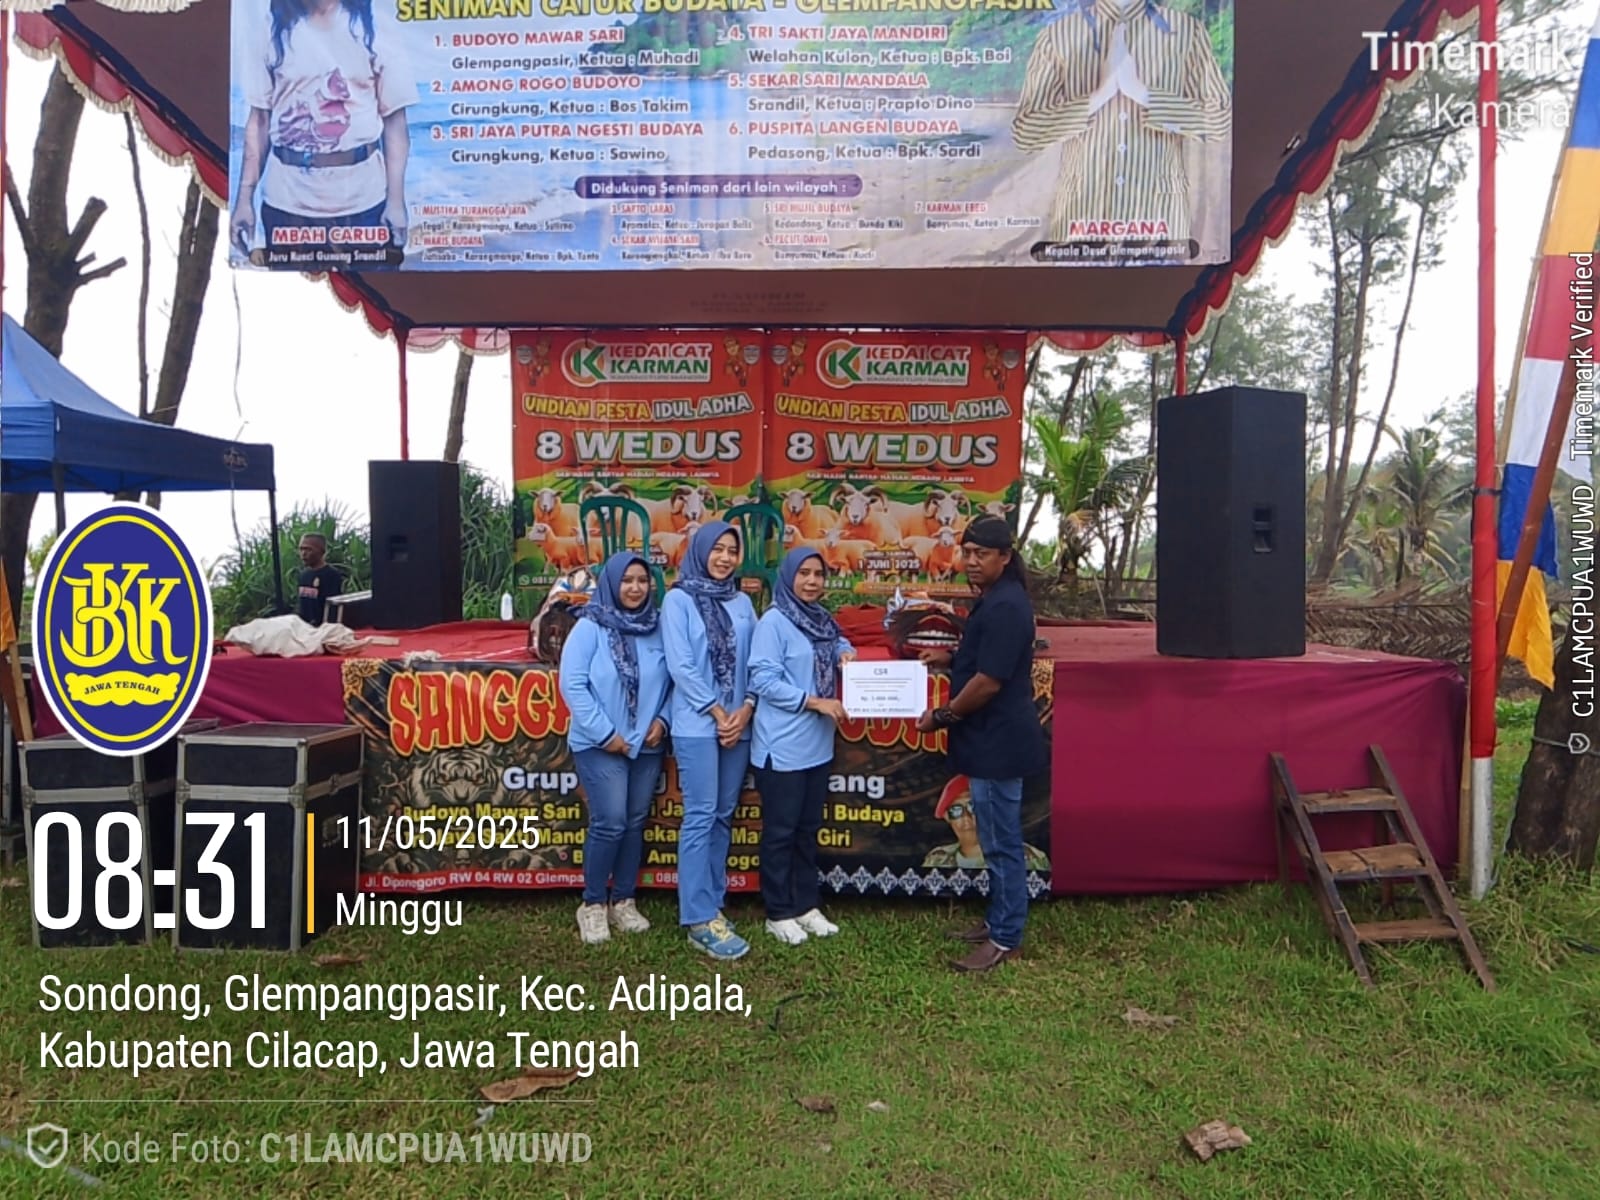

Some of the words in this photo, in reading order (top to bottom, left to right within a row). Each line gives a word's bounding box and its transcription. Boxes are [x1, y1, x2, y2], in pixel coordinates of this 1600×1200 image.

[434, 35, 447, 47] 1.
[452, 32, 519, 47] BUDOYO
[525, 30, 585, 45] MAWAR
[588, 28, 624, 43] SARI
[728, 28, 744, 41] 4.
[748, 26, 773, 39] TRI
[778, 26, 823, 40] SAKTI
[829, 26, 868, 40] JAYA
[873, 26, 947, 40] MANDIRI
[452, 53, 575, 71] Glempangpasir,
[579, 53, 624, 67] Ketua
[638, 51, 699, 65] Muhadi
[748, 50, 819, 64] Welahan
[824, 50, 875, 66] Kulon,
[880, 50, 928, 64] Ketua
[943, 50, 979, 66] Bpk.
[431, 81, 446, 93] 2.
[451, 79, 513, 92] AMONG
[519, 78, 567, 91] ROGO
[572, 76, 641, 89] BUDOYO
[729, 76, 744, 88] 5.
[748, 73, 799, 87] SEKAR
[804, 73, 840, 87] SARI
[845, 72, 928, 87] MANDALA
[451, 102, 544, 117] Cirungkung,
[550, 101, 594, 113] Ketua
[610, 100, 636, 112] Bos
[642, 99, 689, 112] Takim
[748, 98, 810, 113] Srandil,
[815, 98, 862, 111] Ketua
[877, 97, 931, 113] Prapto
[936, 97, 973, 110] Dino
[432, 128, 446, 140] 3.
[451, 125, 473, 138] SRI
[479, 125, 515, 138] JAYA
[521, 124, 572, 137] PUTRA
[577, 123, 633, 137] NGESTI
[639, 122, 704, 136] BUDAYA
[729, 124, 743, 136] 6.
[748, 121, 813, 135] PUSPITA
[819, 120, 888, 134] LANGEN
[893, 120, 959, 133] BUDAYA
[451, 150, 544, 164] Cirungkung,
[550, 149, 594, 162] Ketua
[748, 145, 830, 161] Pedasong,
[836, 145, 882, 159] Ketua
[898, 144, 934, 160] Bpk.
[939, 143, 981, 158] Sardi
[591, 182, 656, 196] Didukung
[660, 182, 718, 194] Seniman
[723, 182, 751, 193] dari
[755, 182, 780, 193] lain
[784, 182, 838, 196] wilayah
[273, 228, 326, 243] MBAH
[330, 227, 389, 243] CARUB
[1069, 221, 1168, 236] MARGANA
[269, 251, 288, 262] Juru
[1045, 244, 1080, 258] Kepala
[1082, 244, 1106, 256] Desa
[610, 345, 667, 358] KEDAI
[672, 345, 709, 358] CAT
[866, 347, 925, 359] KEDAI
[930, 347, 968, 360] CAT
[610, 360, 708, 374] KARMAN
[867, 361, 967, 376] KARMAN
[524, 395, 590, 416] UNDIAN
[596, 401, 650, 419] PESTA
[655, 400, 694, 418] IDUL
[699, 395, 751, 417] ADHA
[777, 395, 844, 418] UNDIAN
[851, 402, 905, 422] PESTA
[911, 403, 950, 422] IDUL
[955, 398, 1010, 420] ADHA
[537, 431, 563, 460] 8
[575, 431, 741, 461] WEDUS
[786, 432, 814, 462] 8
[827, 433, 998, 466] WEDUS
[502, 768, 578, 795] Grup
[828, 774, 885, 799] ang
[542, 803, 581, 819] Sari
[834, 804, 905, 827] Budaya
[537, 828, 586, 844] Mand
[817, 828, 851, 847] Giri
[382, 875, 446, 890] Diponegoro
[450, 872, 472, 884] RW
[493, 873, 513, 884] RW
[517, 872, 532, 883] 02
[535, 872, 585, 884] Glempa
